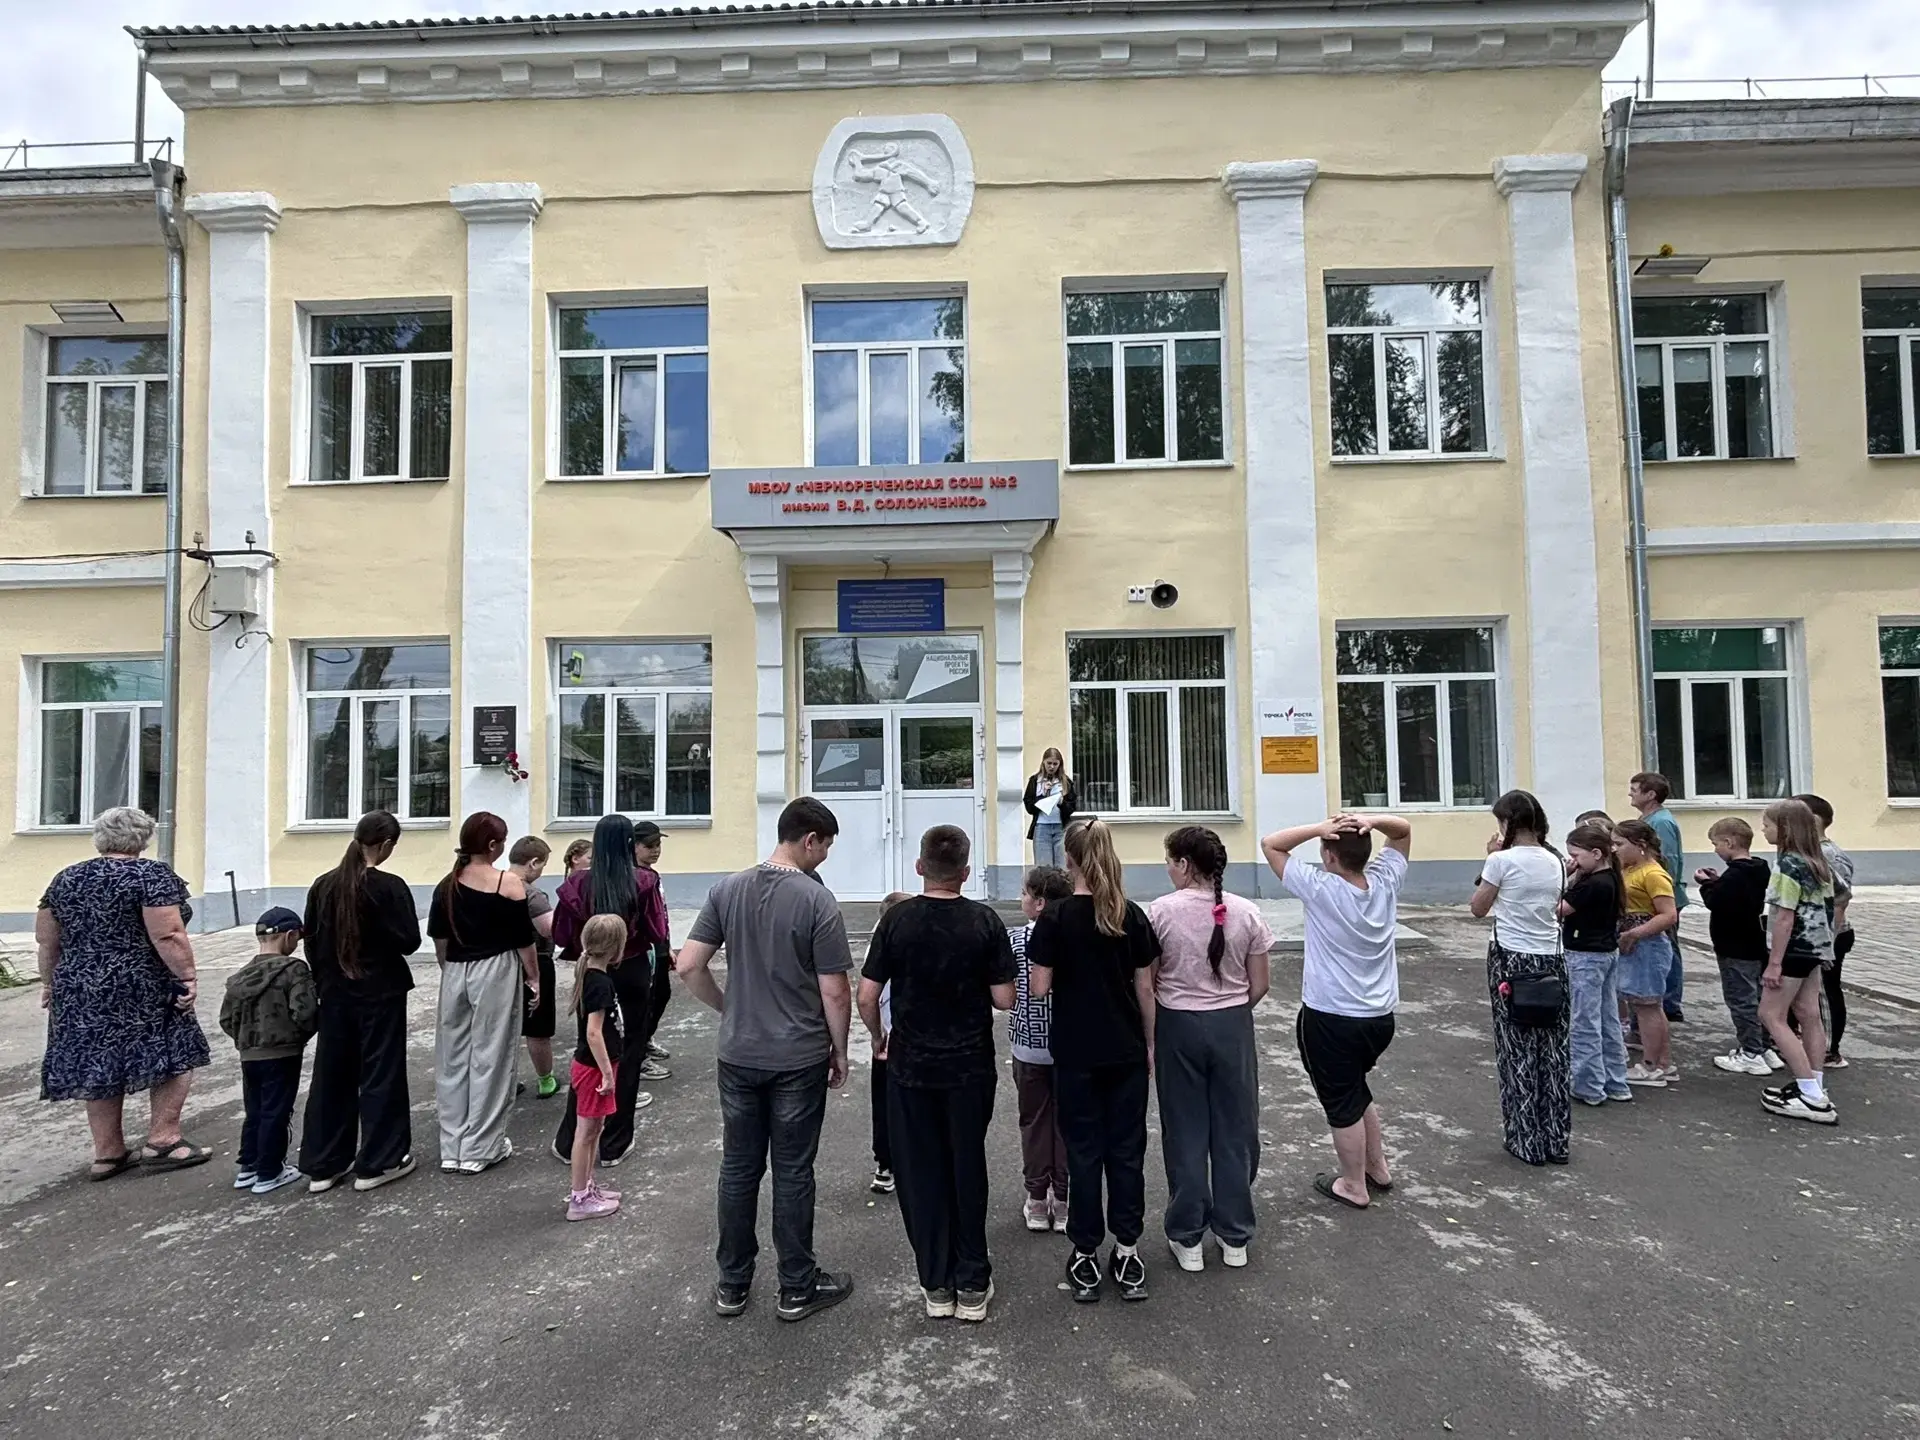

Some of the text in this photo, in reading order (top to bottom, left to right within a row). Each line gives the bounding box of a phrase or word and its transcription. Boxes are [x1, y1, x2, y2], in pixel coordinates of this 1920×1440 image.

[748, 482, 791, 494] МБОУ
[795, 478, 944, 493] «ЧЕРНОРЕЧЕНСКАЯ
[948, 477, 984, 489] СОШ
[782, 502, 830, 513] имени
[874, 496, 987, 510] СОЛОНЧЕНКО»
